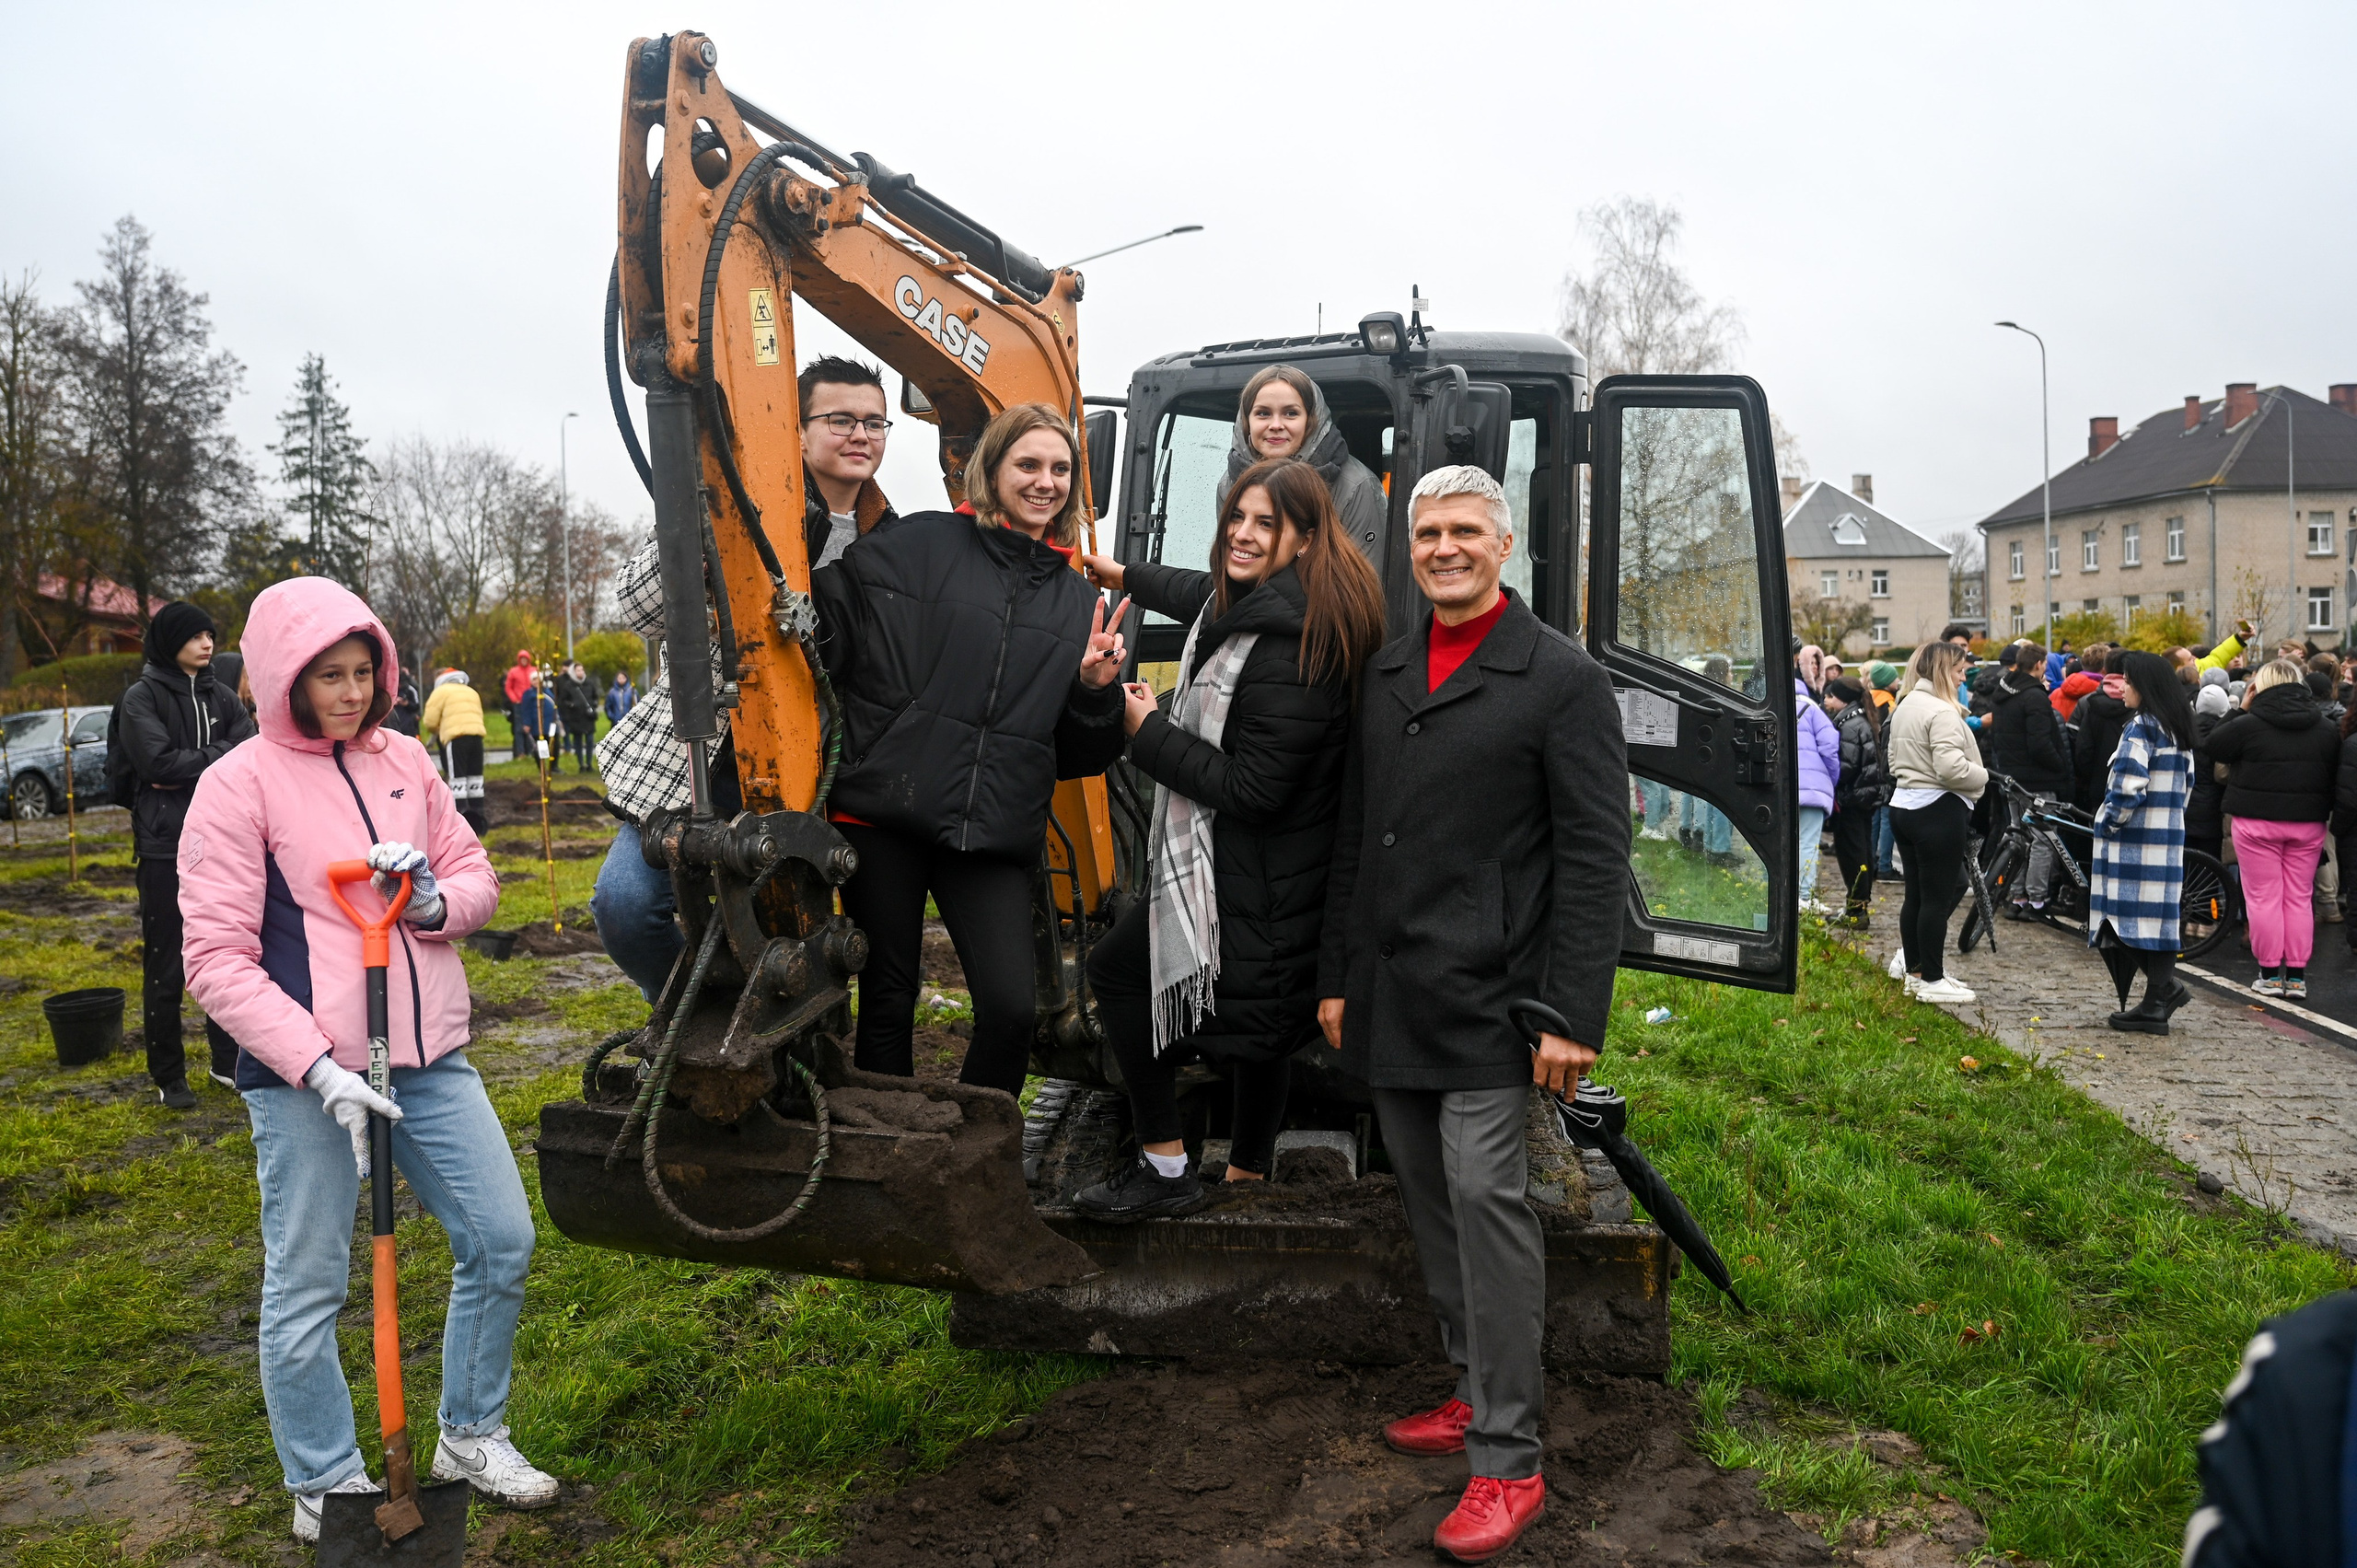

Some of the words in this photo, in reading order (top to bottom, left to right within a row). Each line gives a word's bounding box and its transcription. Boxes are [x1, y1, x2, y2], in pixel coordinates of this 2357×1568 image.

[894, 274, 991, 377] CASE
[389, 788, 404, 799] 4F
[2052, 838, 2083, 884] MALTRACK
